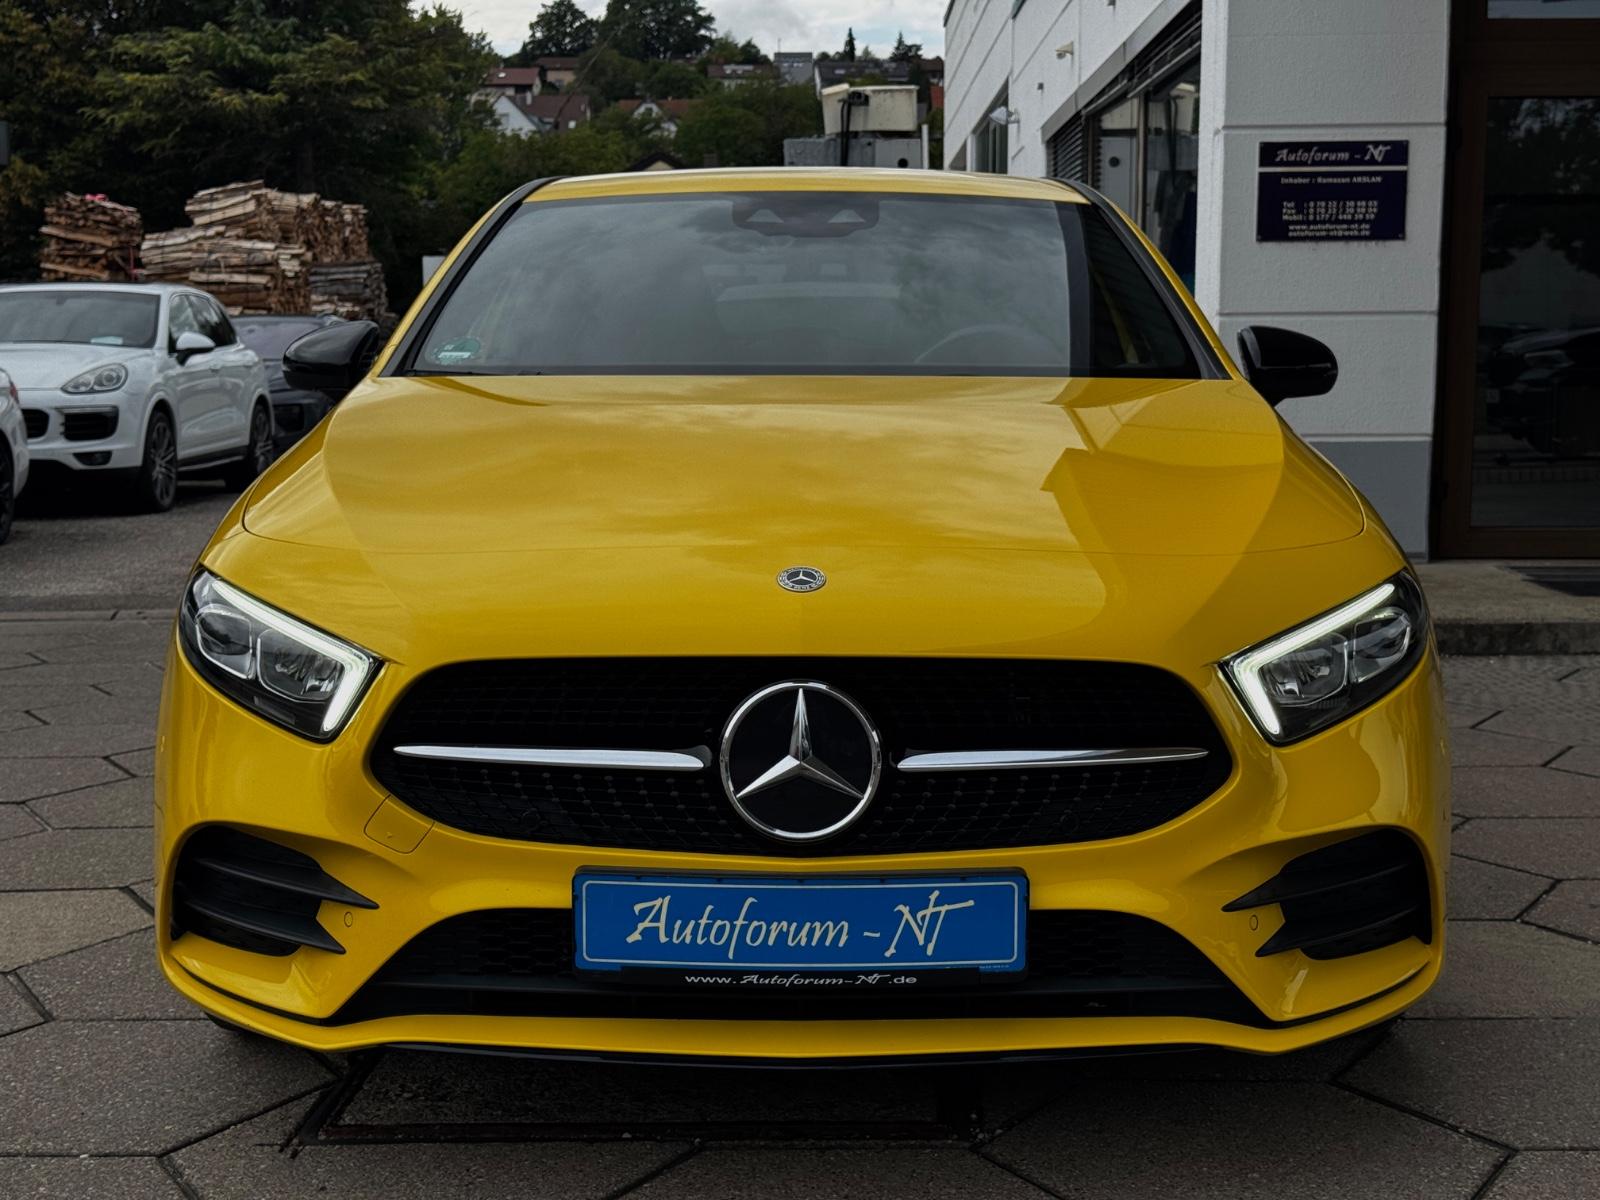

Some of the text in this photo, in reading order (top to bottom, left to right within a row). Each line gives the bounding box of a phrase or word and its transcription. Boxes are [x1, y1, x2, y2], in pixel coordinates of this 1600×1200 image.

[1275, 146, 1350, 165] Autoforum
[1364, 144, 1391, 163] NT
[1280, 176, 1310, 184] Inhaber
[1352, 175, 1382, 184] ARSLAN
[625, 895, 849, 960] Autoforum
[884, 890, 975, 958] NT
